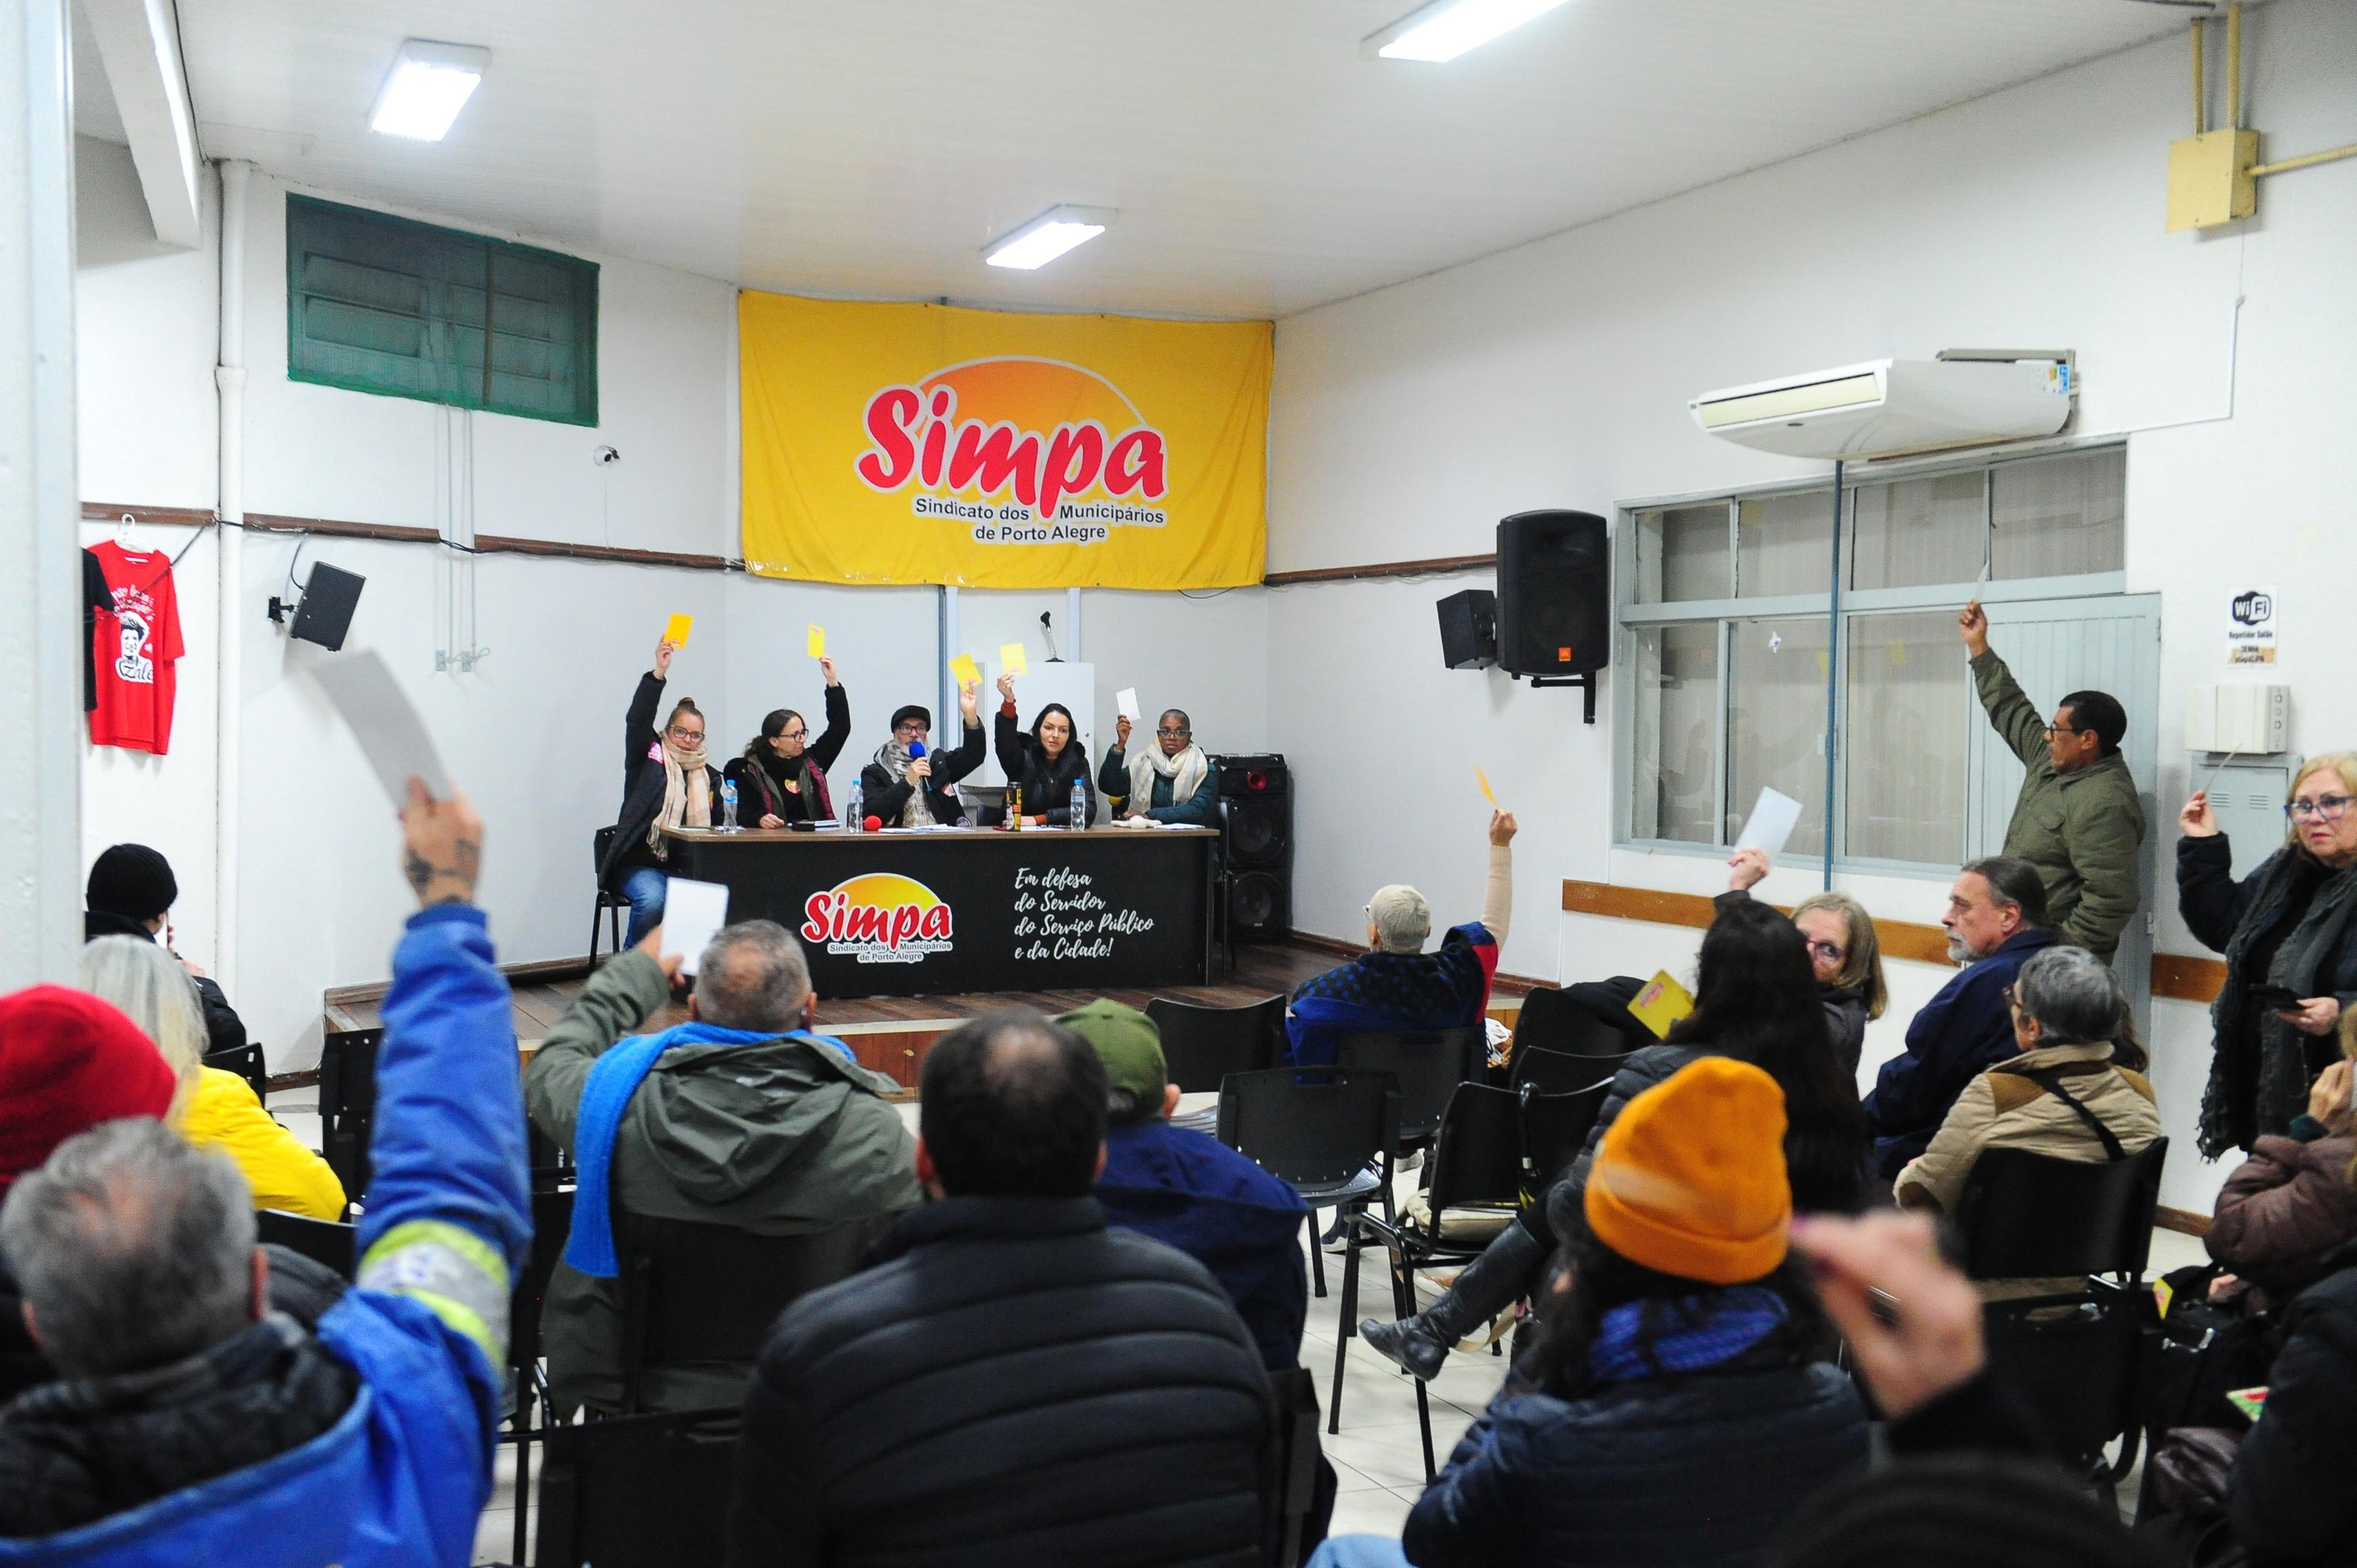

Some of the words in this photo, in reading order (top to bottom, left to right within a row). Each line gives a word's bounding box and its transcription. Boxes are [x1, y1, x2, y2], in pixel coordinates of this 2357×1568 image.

[857, 387, 1166, 519] Simpa
[915, 497, 994, 520] Sindicato
[1000, 505, 1030, 521] dos
[1059, 503, 1164, 523] Municipários
[975, 526, 996, 541] de
[1001, 526, 1047, 542] Porto
[1051, 525, 1106, 543] Alegre
[1014, 867, 1039, 890] Em
[1042, 866, 1092, 891] defesa
[1014, 891, 1037, 913] do
[1039, 889, 1106, 912] Servidor
[802, 892, 952, 950] Simpa
[1014, 915, 1037, 937] do
[1039, 913, 1095, 937] Serviço
[1098, 908, 1155, 935] Público
[830, 943, 868, 952] Sindicato
[899, 941, 952, 951] Municipários
[896, 952, 923, 962] Alegre
[1014, 946, 1024, 960] e
[1026, 939, 1050, 960] da
[1053, 936, 1114, 960] Cidade!
